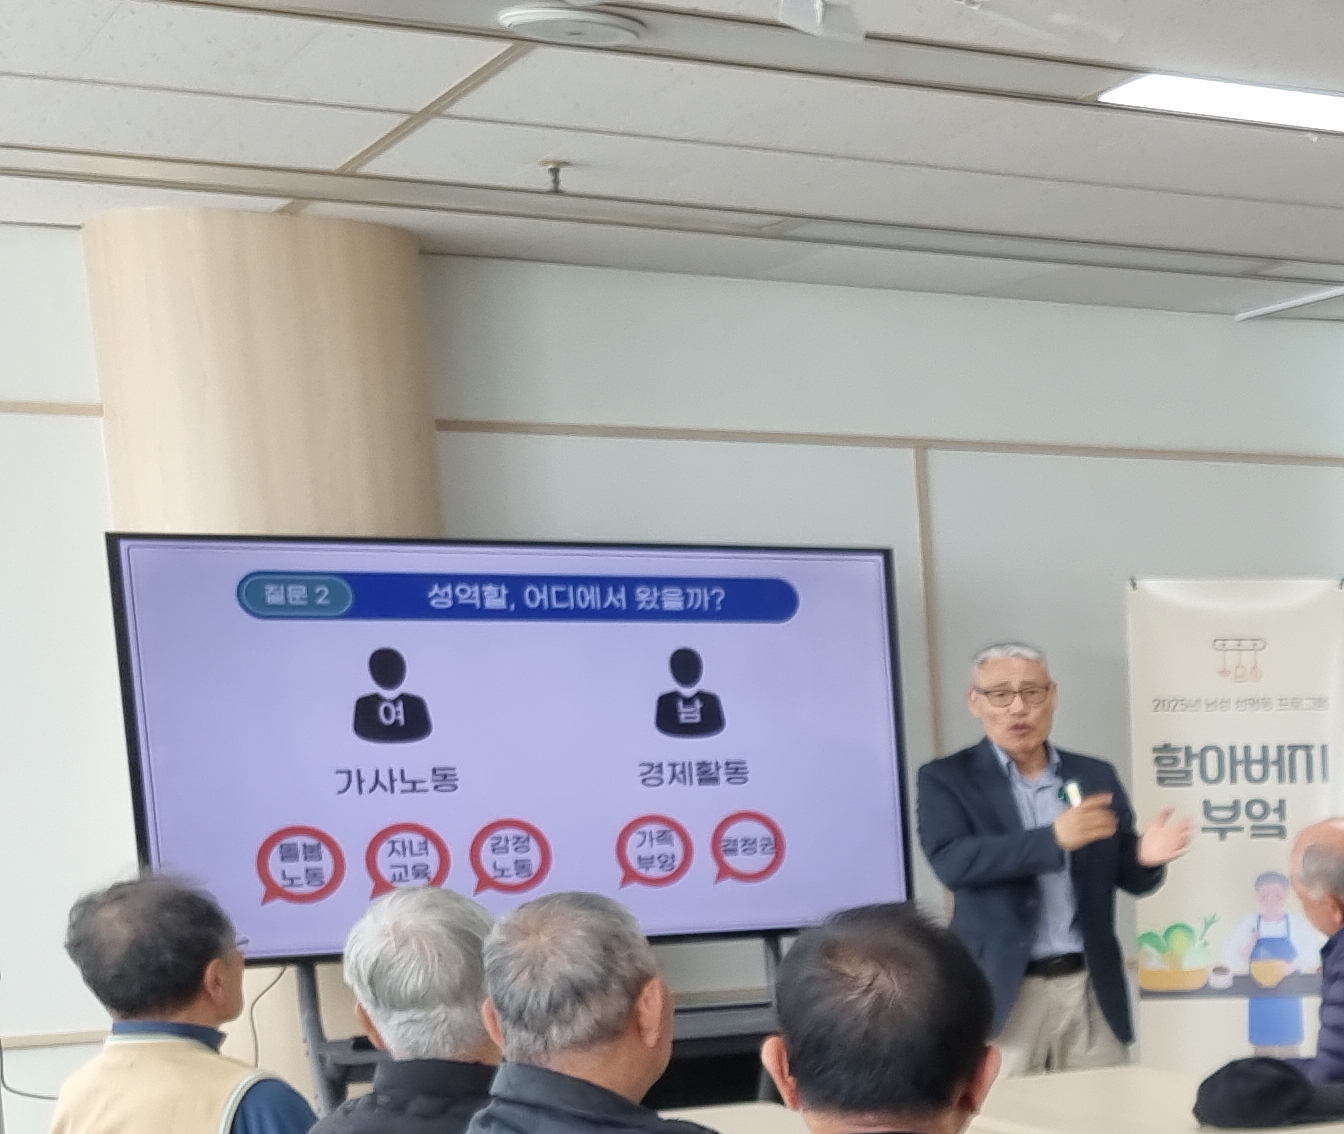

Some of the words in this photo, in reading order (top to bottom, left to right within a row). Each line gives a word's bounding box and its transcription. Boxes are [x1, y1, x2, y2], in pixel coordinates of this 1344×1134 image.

[264, 583, 309, 607] 질문
[314, 585, 331, 605] 2
[427, 582, 516, 612] 성역할,
[524, 583, 627, 611] 어디에서
[634, 585, 726, 612] 왔을까?
[378, 700, 405, 727] 여
[676, 699, 704, 725] 남
[638, 759, 751, 789] 경제활동
[1152, 742, 1330, 788] 할아버지
[335, 765, 460, 797] 가사노동
[1201, 798, 1287, 841] 부엌
[387, 837, 430, 859] 자녀
[490, 834, 531, 855] 감정
[636, 829, 675, 849] 가족
[720, 836, 778, 857] 결정권
[388, 862, 431, 883] 교육
[491, 857, 533, 879] 노동
[636, 853, 676, 872] 부양
[281, 867, 326, 888] 노동
